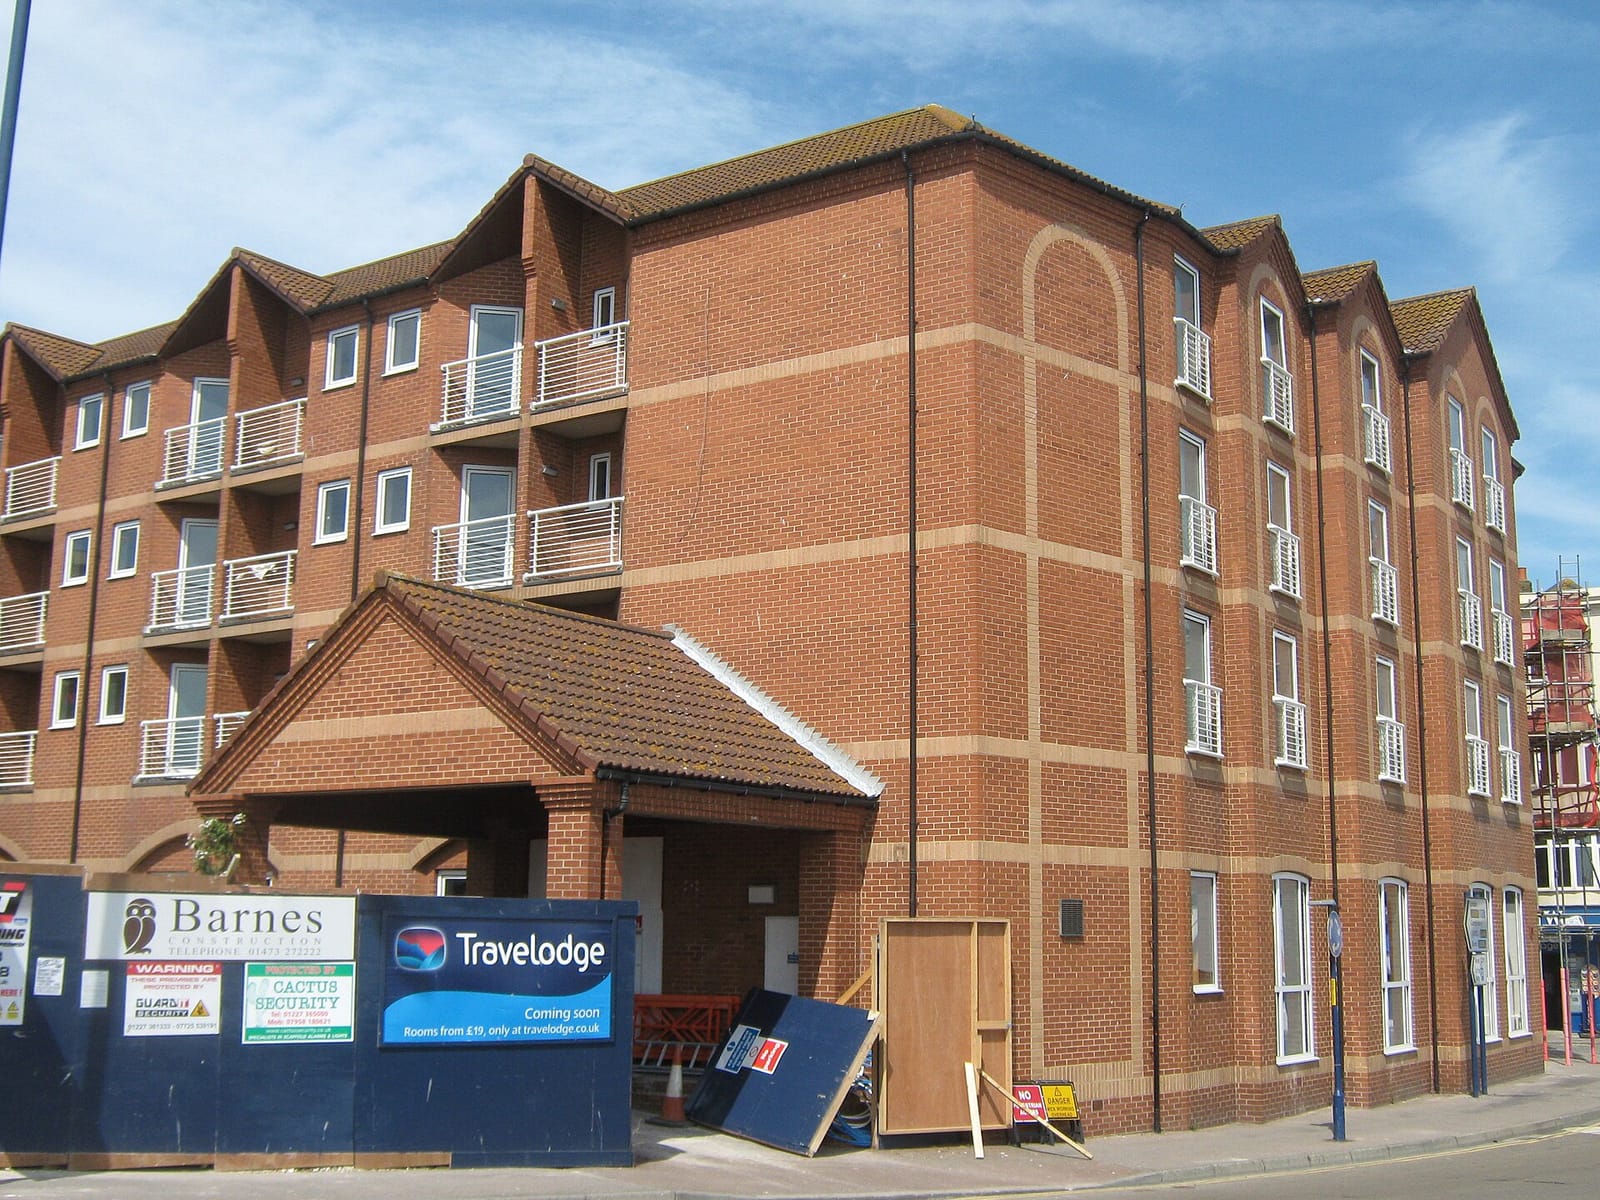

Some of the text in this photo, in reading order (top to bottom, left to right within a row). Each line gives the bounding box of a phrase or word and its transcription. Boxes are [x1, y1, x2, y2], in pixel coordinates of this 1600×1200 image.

[170, 899, 322, 934] Barnes
[168, 937, 321, 945] CONSTRUCTION
[168, 948, 241, 956] TELEPHONE
[248, 948, 280, 956] 01473
[455, 932, 605, 972] Travelodge
[135, 964, 214, 974] WARNING
[273, 981, 338, 993] CACTUS
[255, 997, 340, 1010] SECURITY
[524, 1008, 600, 1022] Coming soon
[404, 1023, 600, 1038] Rooms from £19, only at travelodge.co.uk
[1018, 1090, 1032, 1100] NO
[1047, 1097, 1072, 1105] DANGER
